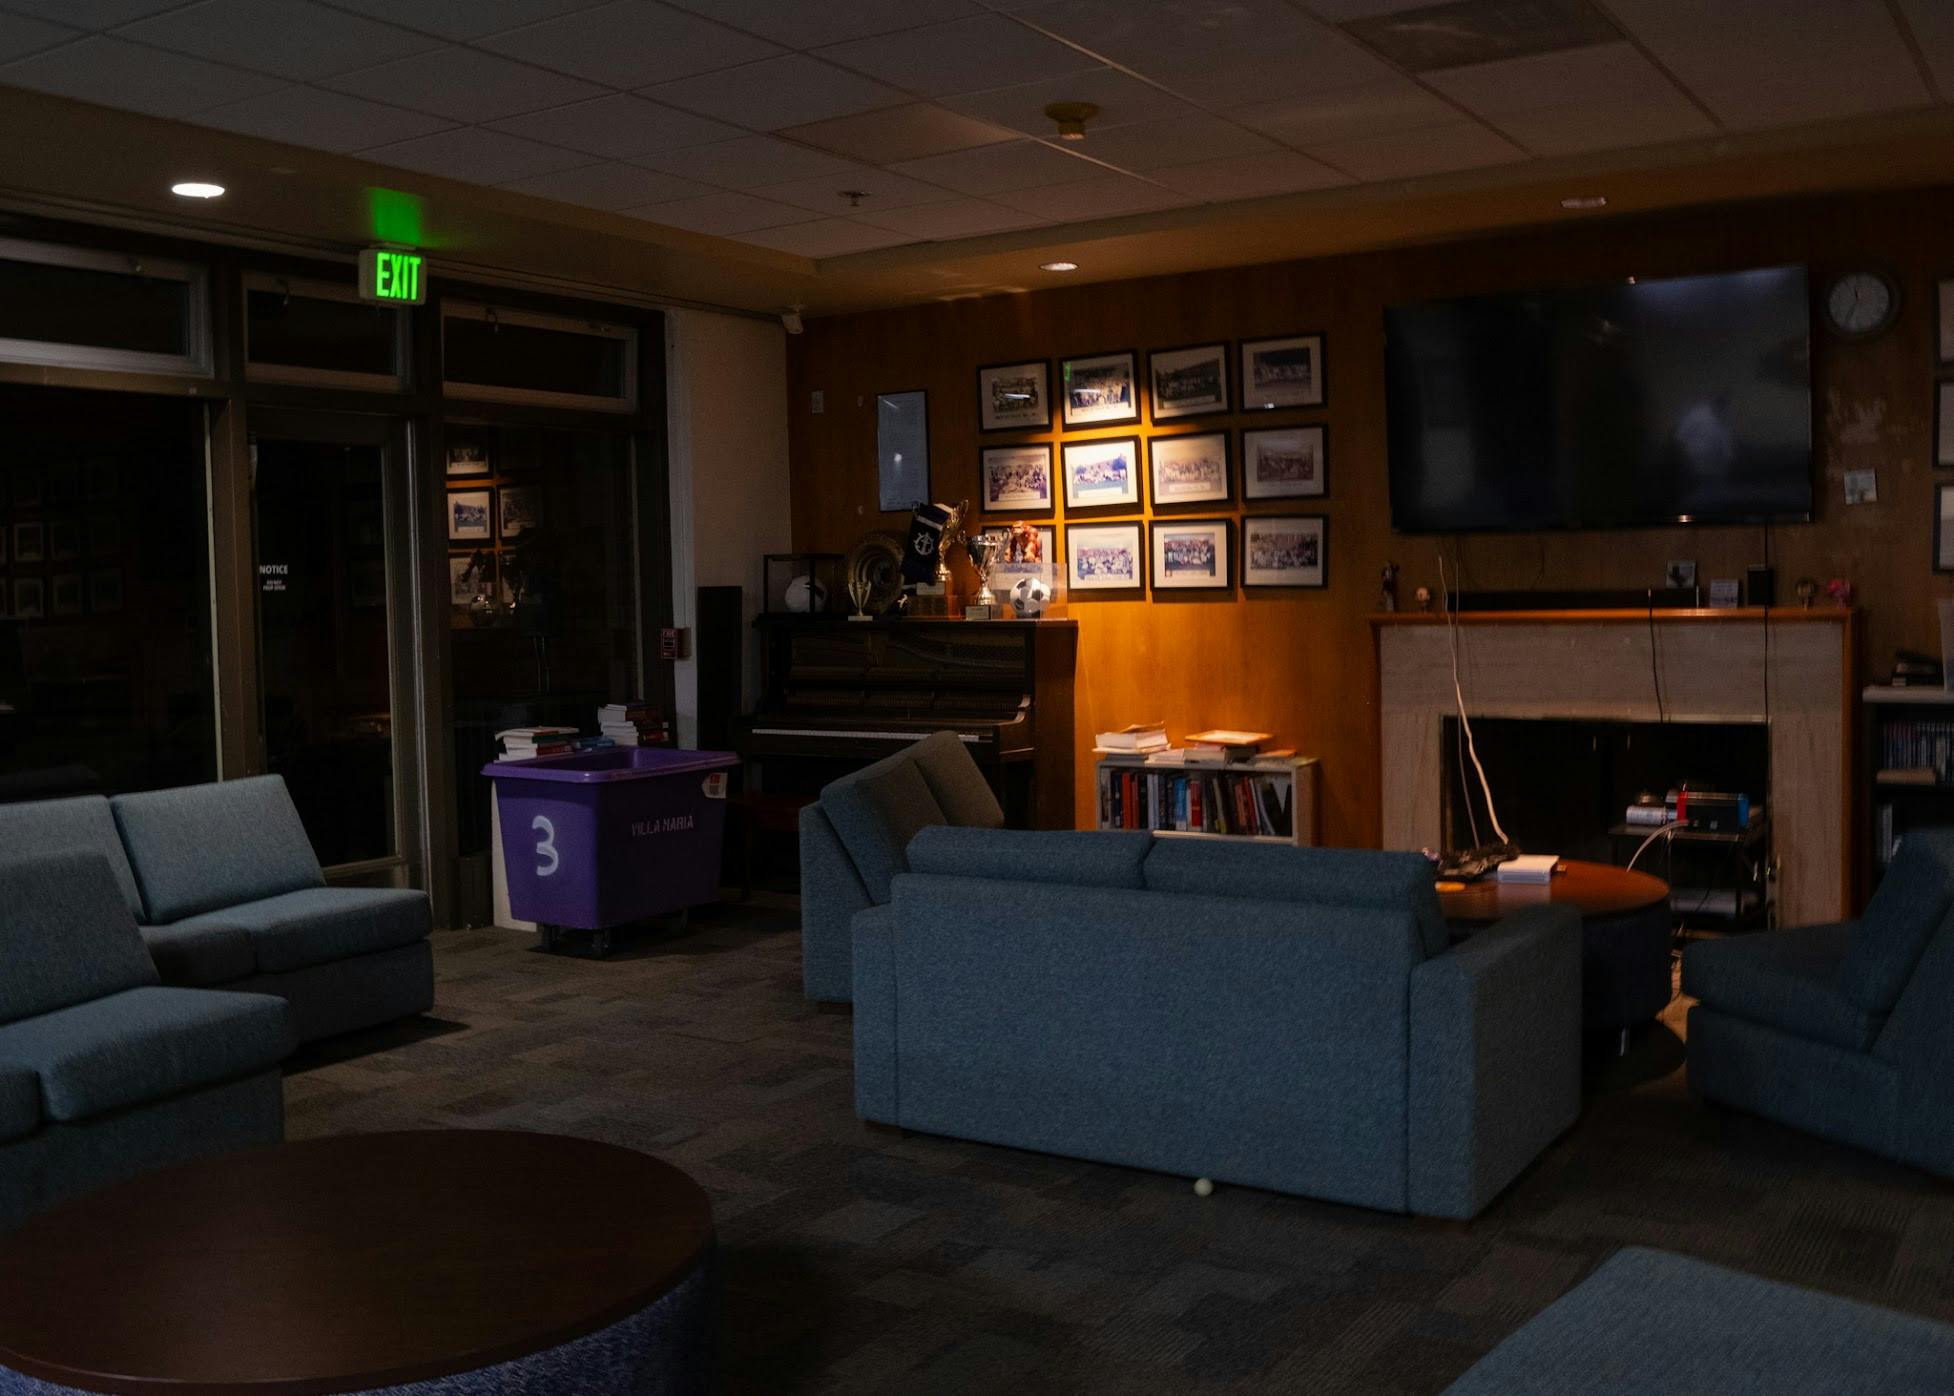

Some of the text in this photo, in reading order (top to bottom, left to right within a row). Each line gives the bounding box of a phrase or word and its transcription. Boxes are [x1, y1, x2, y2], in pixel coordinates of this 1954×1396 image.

[376, 252, 421, 300] EXIT
[259, 564, 288, 575] NOTICE
[632, 819, 660, 837] VILLA
[532, 815, 559, 877] 3
